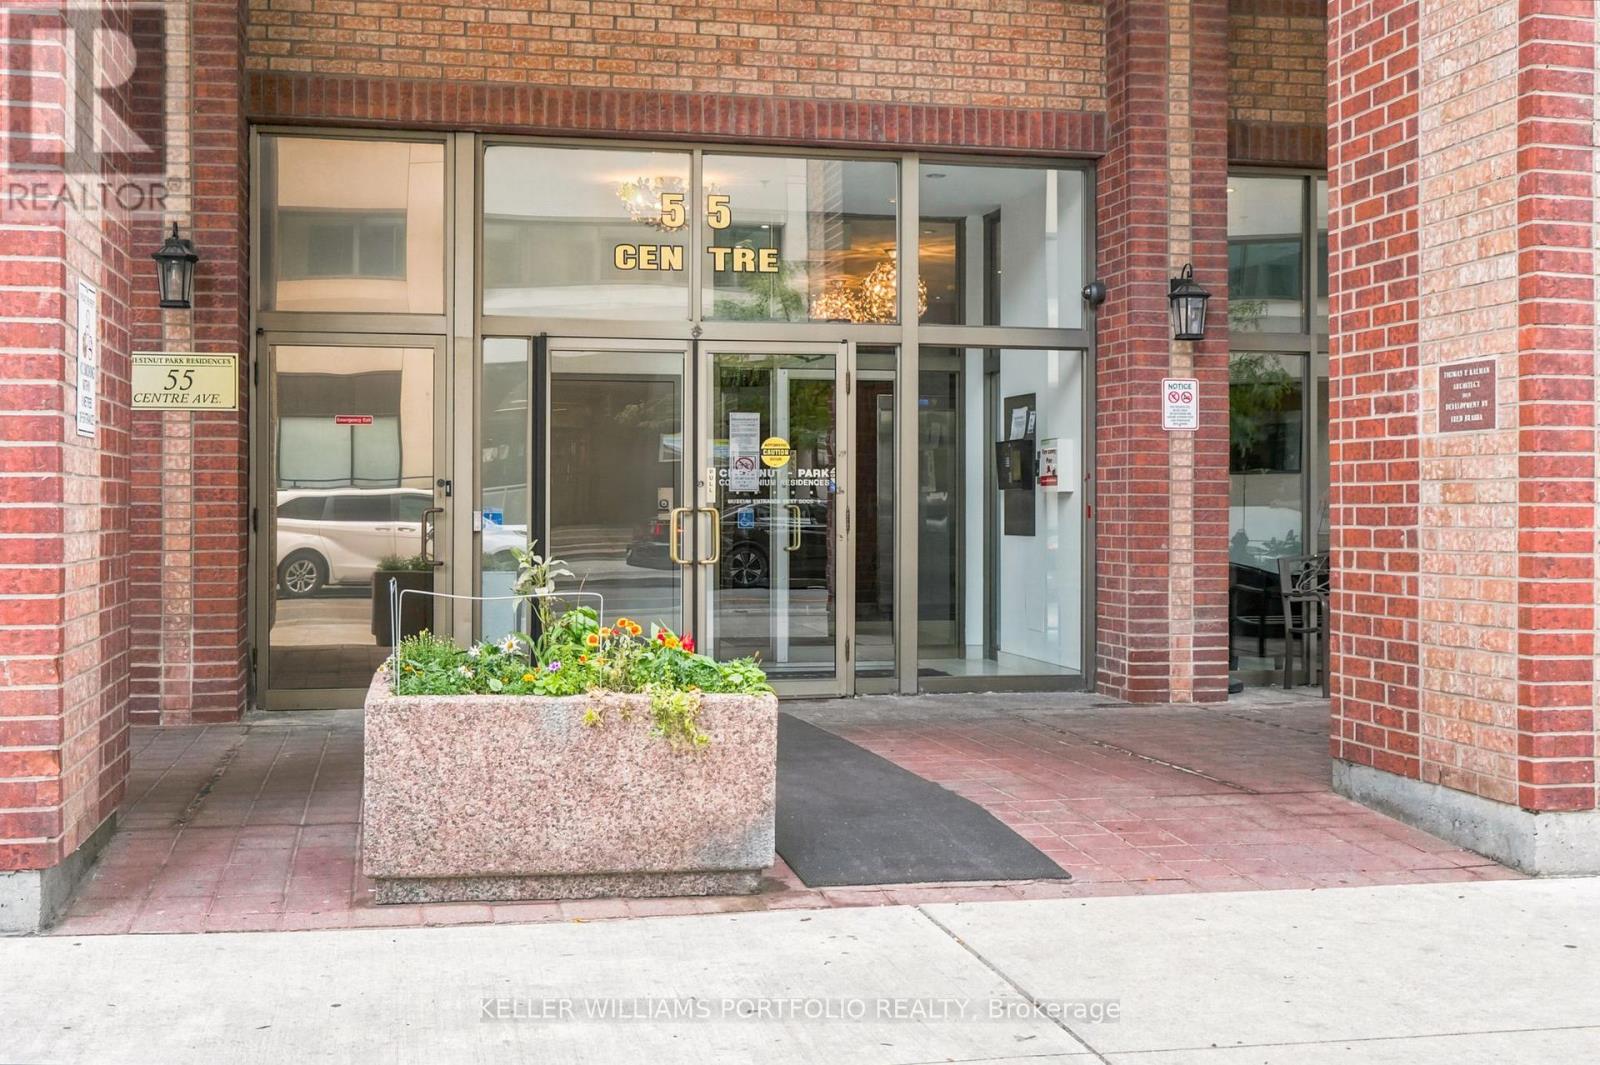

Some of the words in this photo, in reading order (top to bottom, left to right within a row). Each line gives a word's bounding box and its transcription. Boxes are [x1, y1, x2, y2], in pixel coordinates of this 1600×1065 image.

[164, 369, 195, 391] 55
[133, 393, 190, 403] CENTRE
[192, 394, 222, 404] AVE.
[798, 468, 829, 478] PARK
